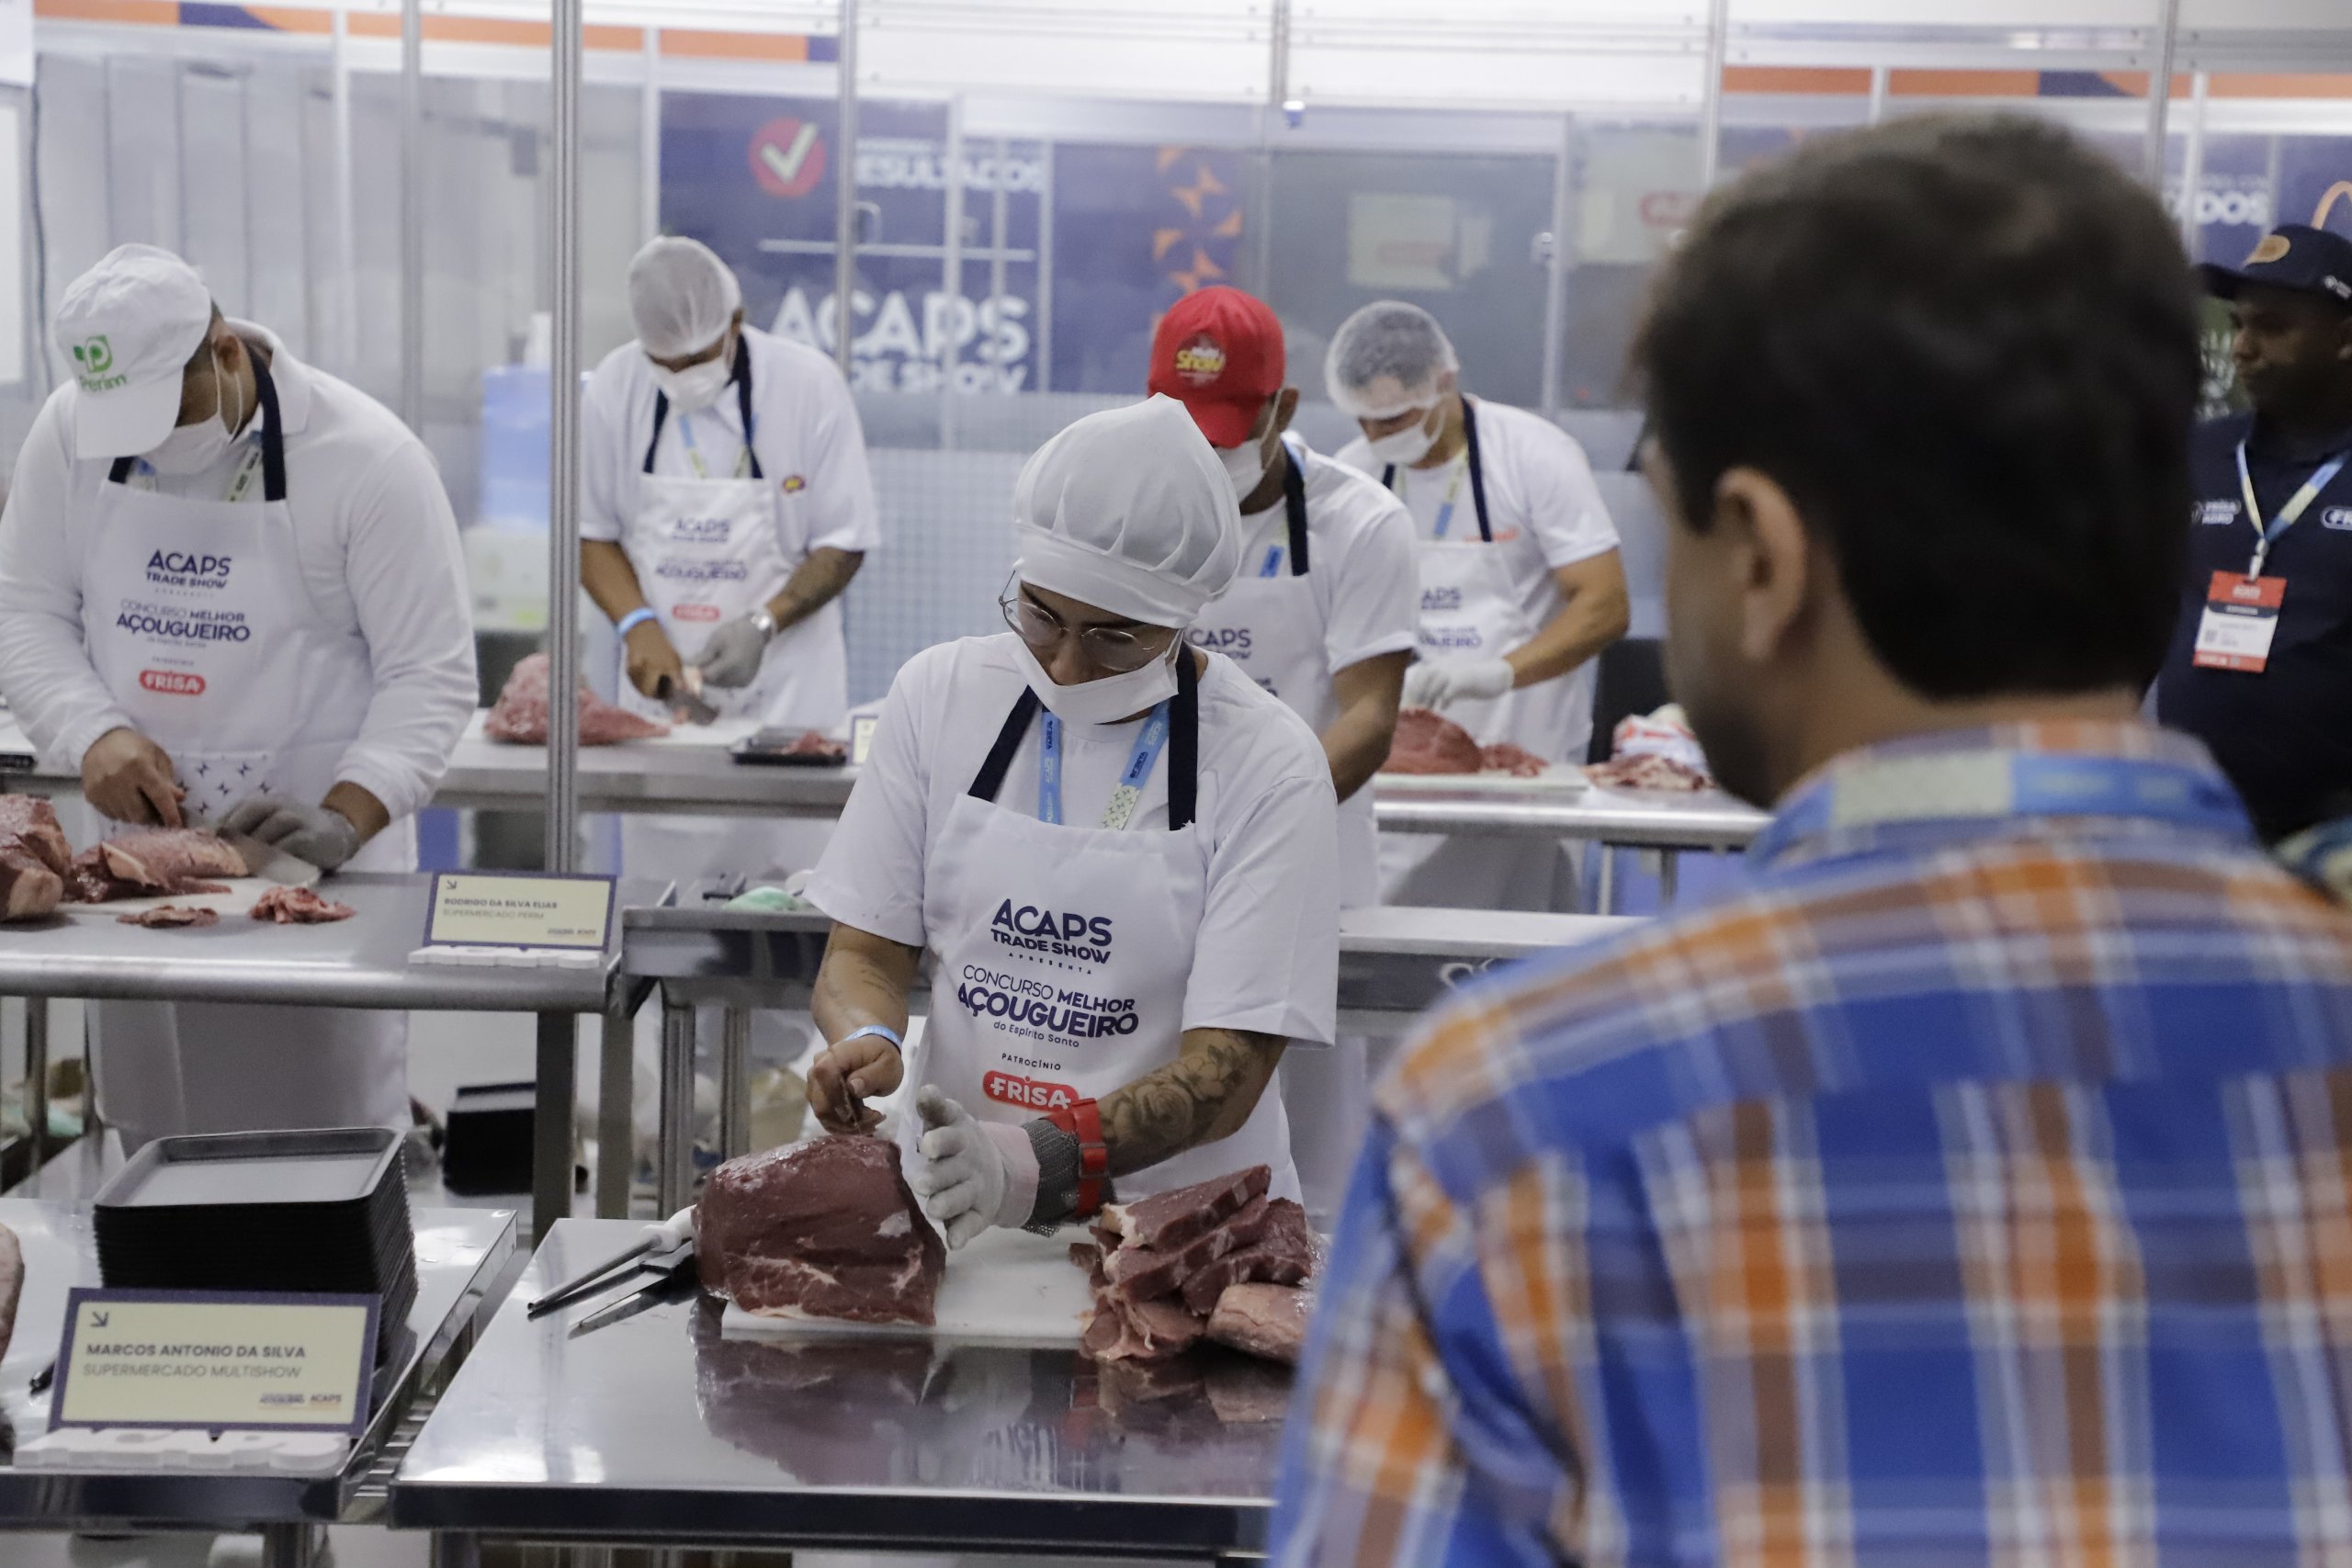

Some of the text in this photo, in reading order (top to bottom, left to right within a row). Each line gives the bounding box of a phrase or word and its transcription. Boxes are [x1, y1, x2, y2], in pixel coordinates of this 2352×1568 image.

[770, 285, 1030, 366] ACAPS
[147, 549, 232, 577] ACAPS
[147, 571, 227, 589] TRADE SHOW
[1422, 588, 1461, 603] APS
[120, 599, 244, 623] CONCURSO MELHOR
[117, 612, 251, 642] AÇOUGUEIRO
[1189, 627, 1252, 649] CAPS
[443, 908, 516, 919] SUPERMERCADO
[444, 897, 558, 909] RODRIGO DA SILVA ELIAS
[991, 898, 1114, 947] ACAPS
[990, 928, 1112, 964] TRADE SHOW
[1008, 952, 1092, 975] APRESENTA
[963, 964, 1136, 1013] CONCURSO MELHOR
[957, 982, 1139, 1039] AÇOUGUEIRO
[993, 1021, 1080, 1048] do Espírito Santo
[1001, 1053, 1062, 1071] PATROCÍNIO
[989, 1076, 1071, 1111] FRISA
[86, 1344, 306, 1359] MARCOS ANTONIO DA SILVA
[82, 1363, 302, 1379] SUPERMERCADO MULTISHOW
